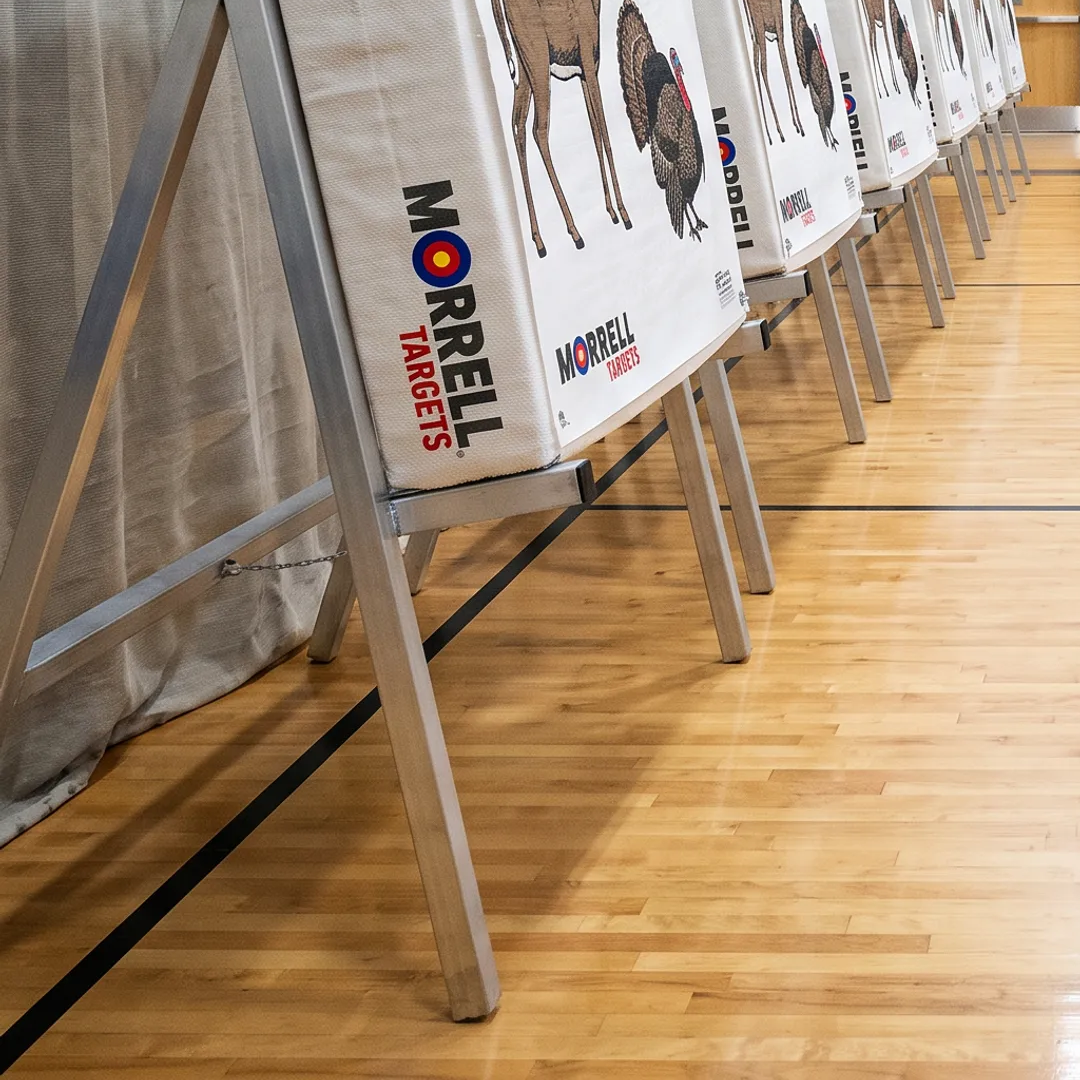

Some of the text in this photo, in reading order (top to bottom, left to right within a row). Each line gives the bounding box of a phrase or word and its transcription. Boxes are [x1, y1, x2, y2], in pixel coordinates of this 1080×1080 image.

[402, 179, 504, 449] MORRELL
[555, 312, 635, 385] MORRELL
[606, 345, 641, 381] TARGETS
[399, 325, 452, 452] TARGETS
